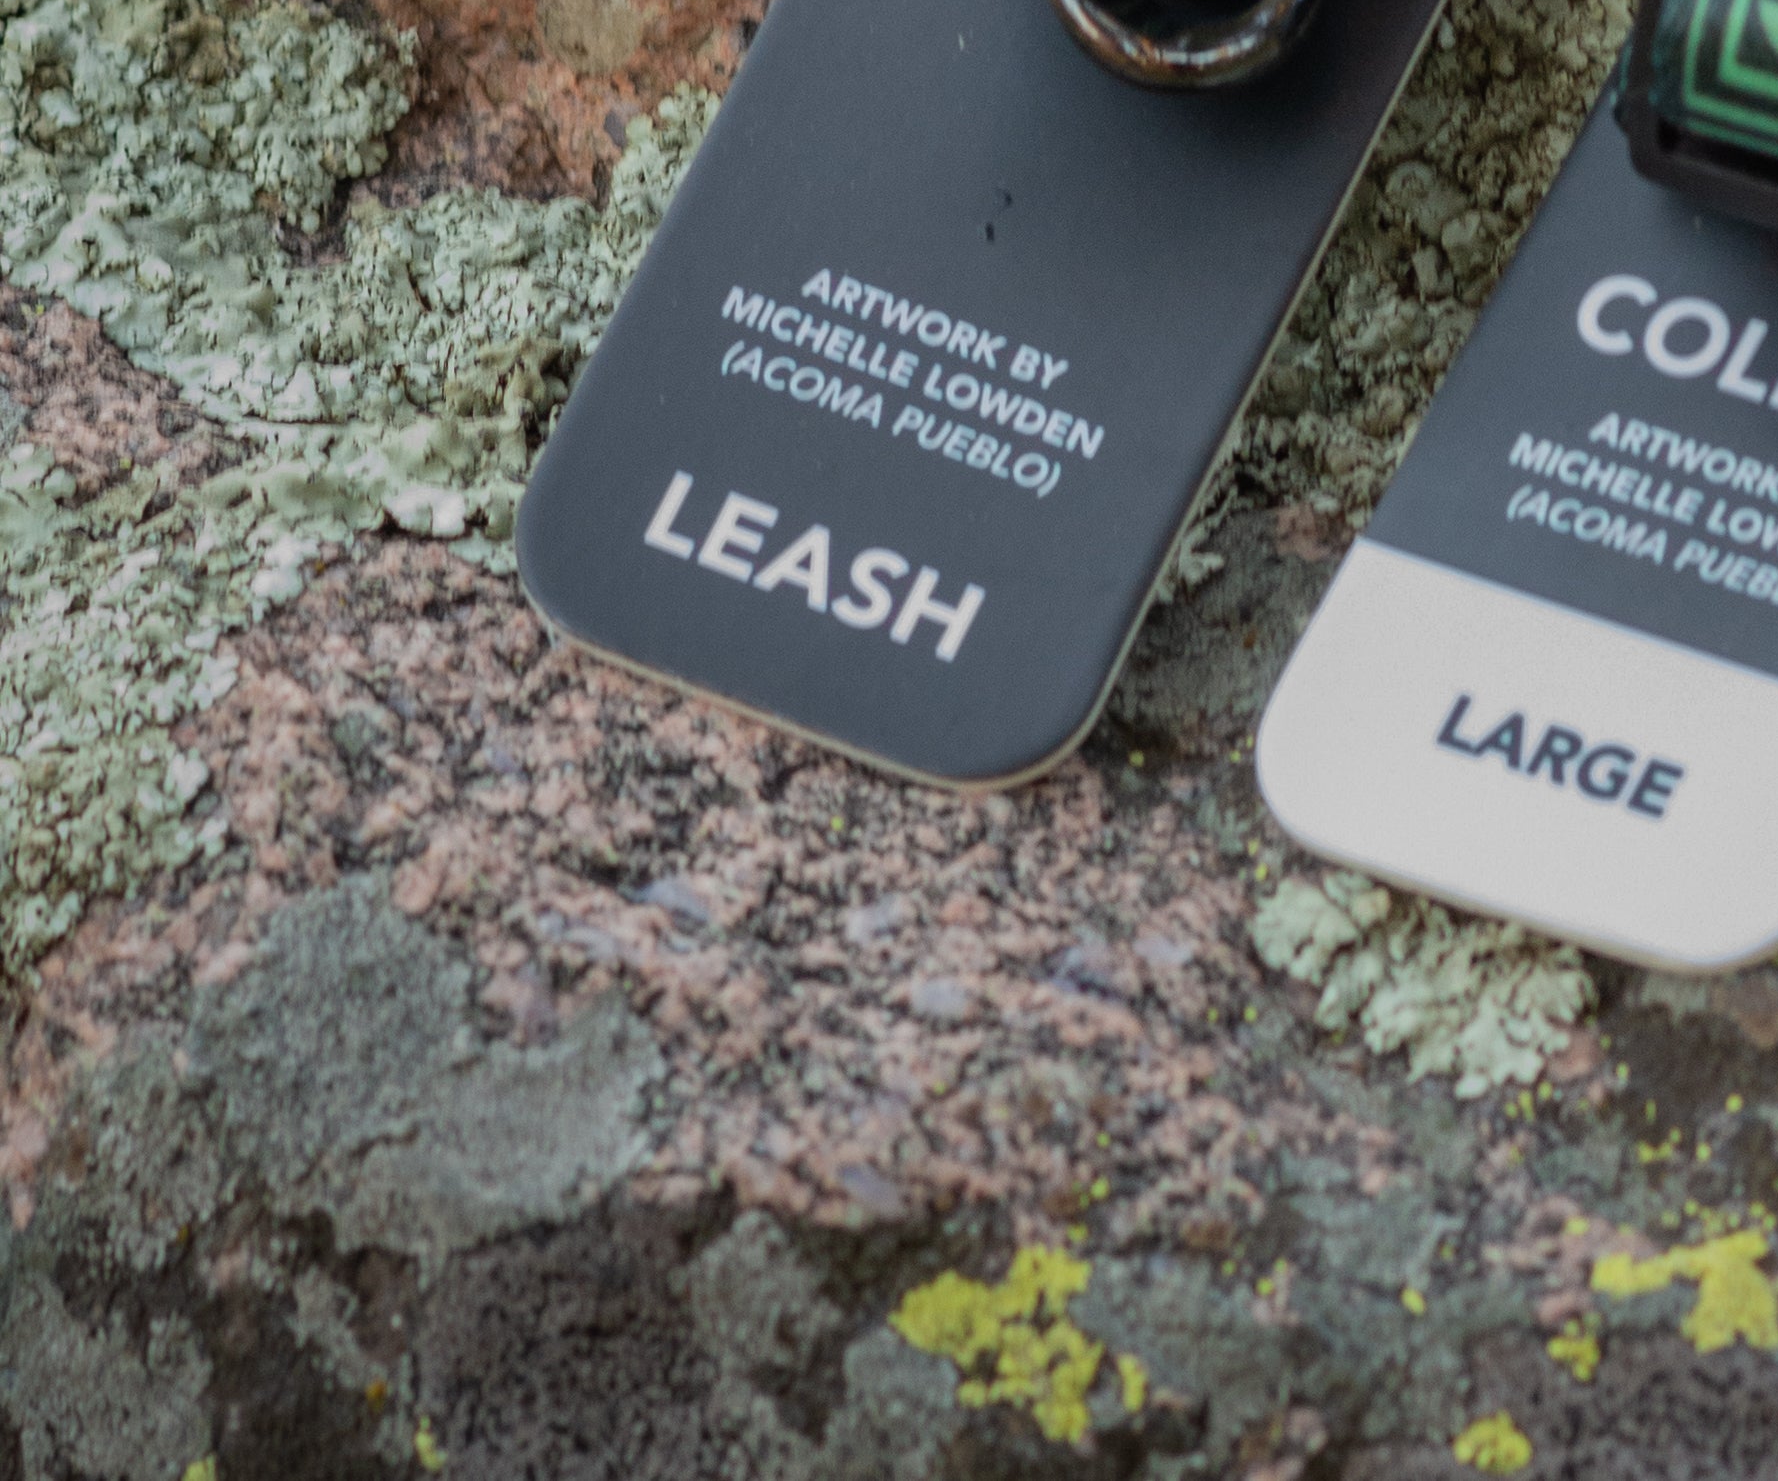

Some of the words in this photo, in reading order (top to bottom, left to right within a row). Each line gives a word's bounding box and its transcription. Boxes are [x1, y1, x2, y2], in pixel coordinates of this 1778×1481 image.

[721, 285, 920, 389] MICHELLE
[923, 363, 1105, 460] LOWDEN
[802, 267, 1007, 369] ARTWORK
[1009, 344, 1069, 390] BY
[720, 340, 885, 429] (ACOMA
[892, 404, 1062, 499] PUEBLO)
[1508, 433, 1704, 525] MICHELLE
[643, 470, 986, 663] LEASH
[1506, 485, 1670, 565] (ACOMA
[1435, 694, 1685, 818] LARGE
